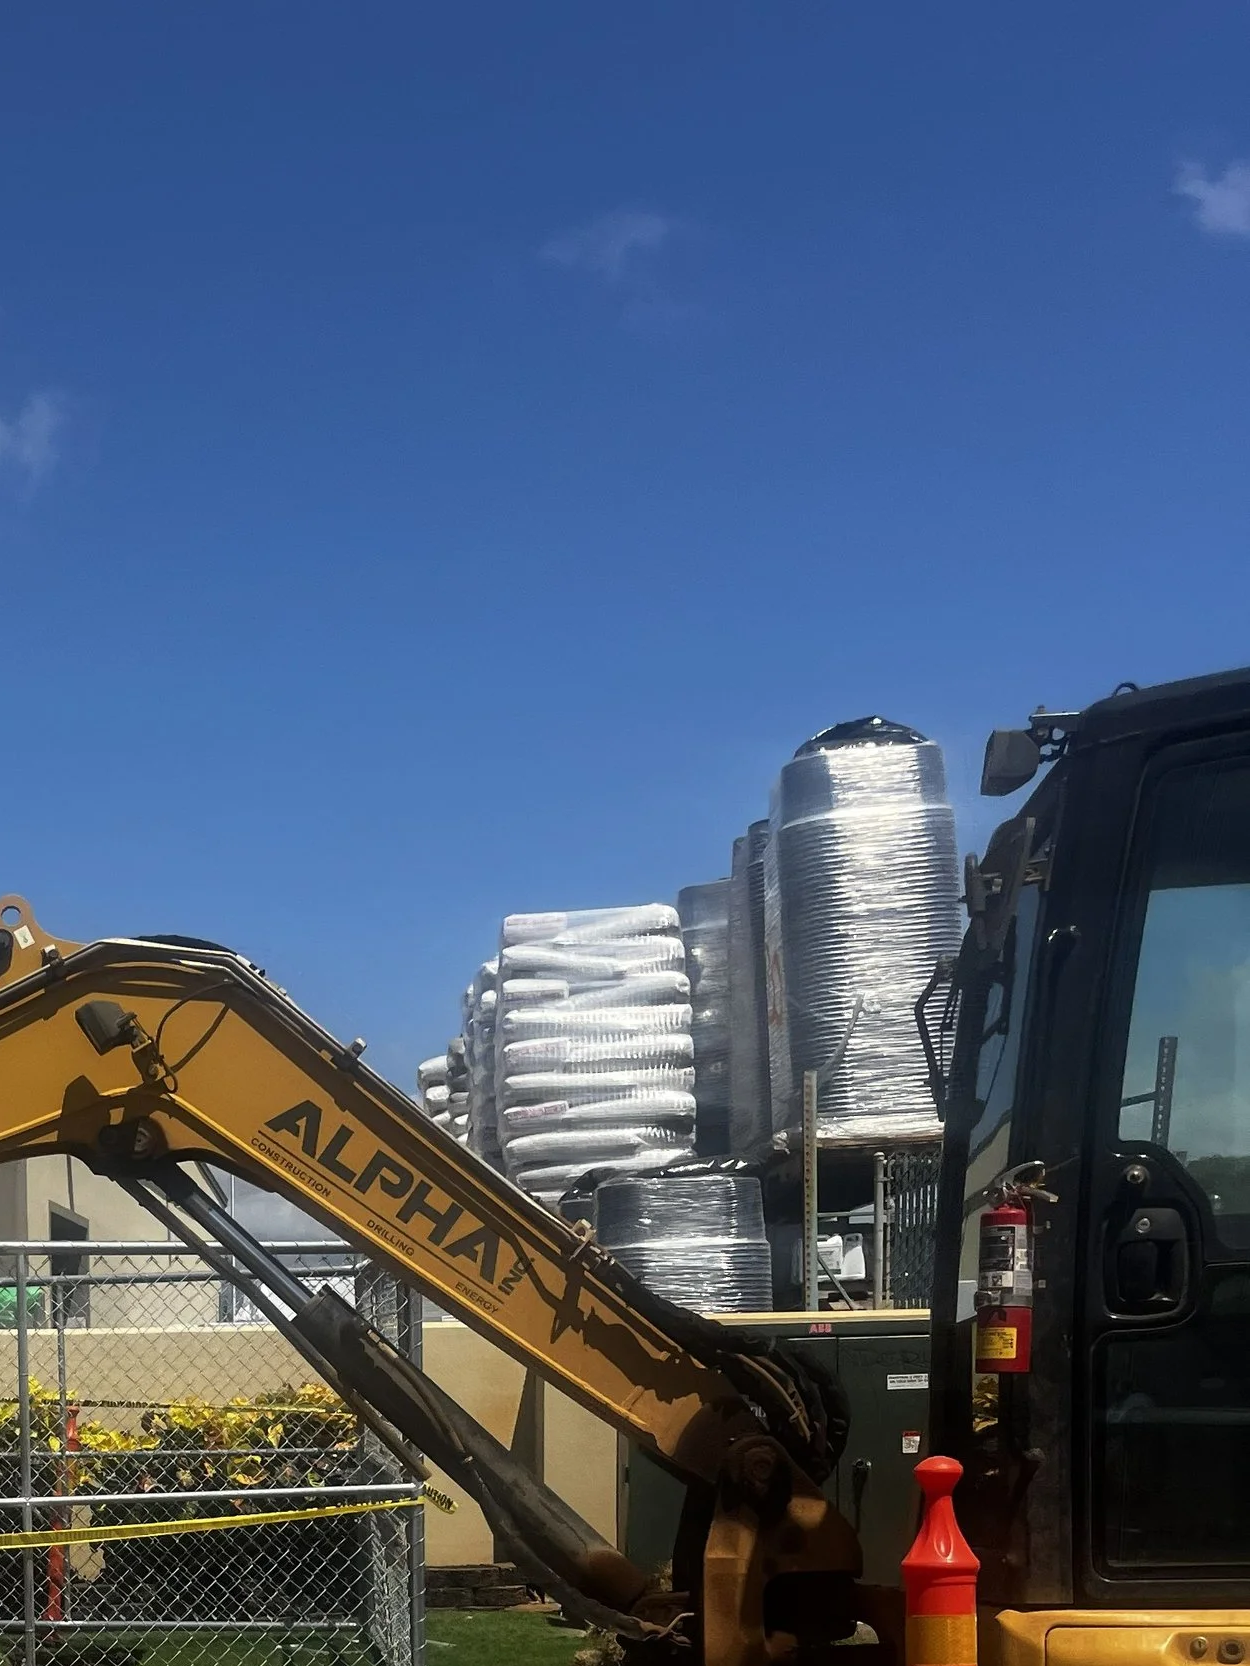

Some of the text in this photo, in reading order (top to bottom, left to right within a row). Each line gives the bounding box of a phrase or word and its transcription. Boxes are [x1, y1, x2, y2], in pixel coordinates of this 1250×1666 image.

[251, 1137, 499, 1313] CONSTRUCTION DRILLING ENERGY
[263, 1100, 500, 1285] ALPHA
[423, 1484, 454, 1511] AUTION
